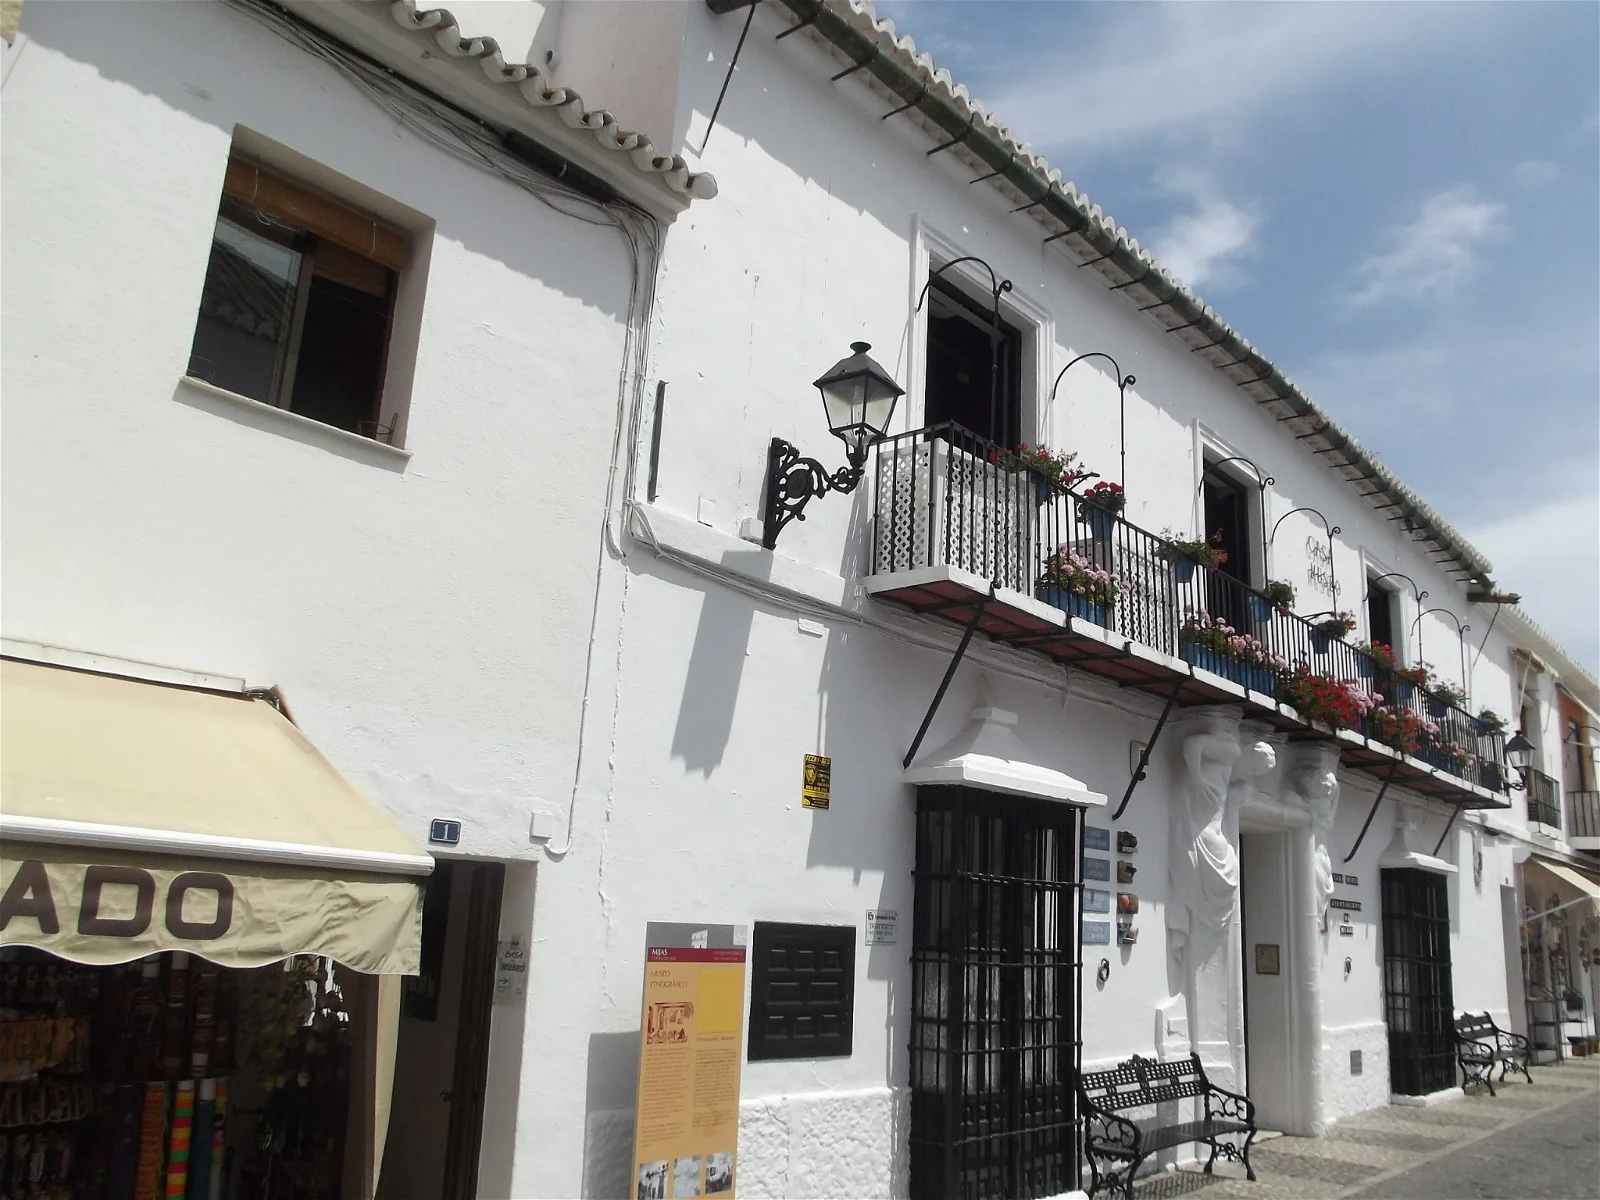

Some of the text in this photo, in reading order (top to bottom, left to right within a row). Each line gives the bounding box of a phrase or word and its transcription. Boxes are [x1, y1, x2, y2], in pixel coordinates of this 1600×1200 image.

[442, 822, 450, 840] 1
[0, 860, 235, 941] ADO
[651, 948, 668, 956] MIJAS
